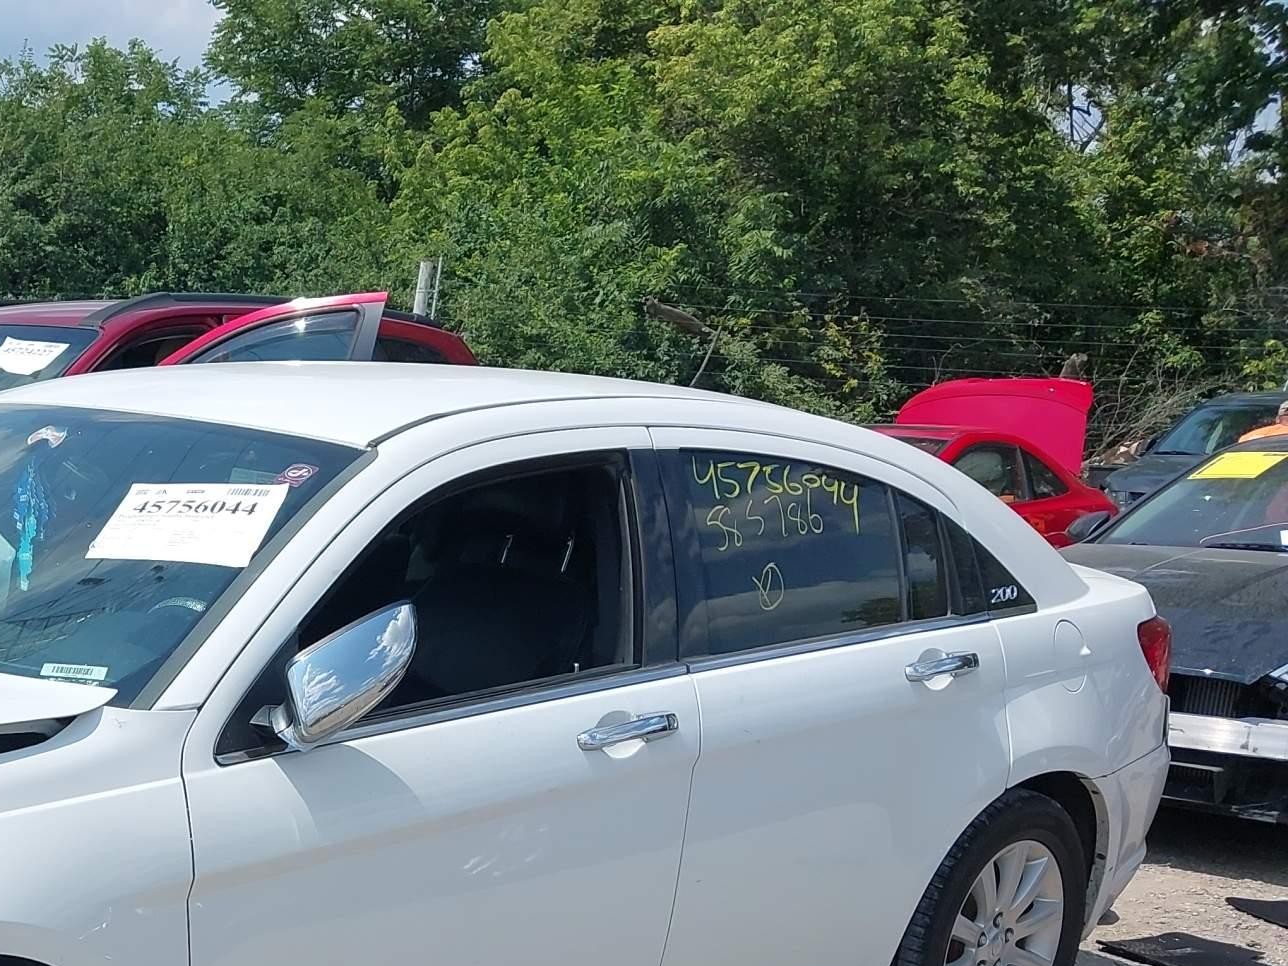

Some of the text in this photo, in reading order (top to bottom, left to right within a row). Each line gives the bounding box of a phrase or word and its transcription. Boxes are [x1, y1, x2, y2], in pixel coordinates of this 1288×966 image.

[692, 456, 859, 535] 45756044
[132, 500, 259, 516] 45756044
[991, 585, 1018, 603] 200
